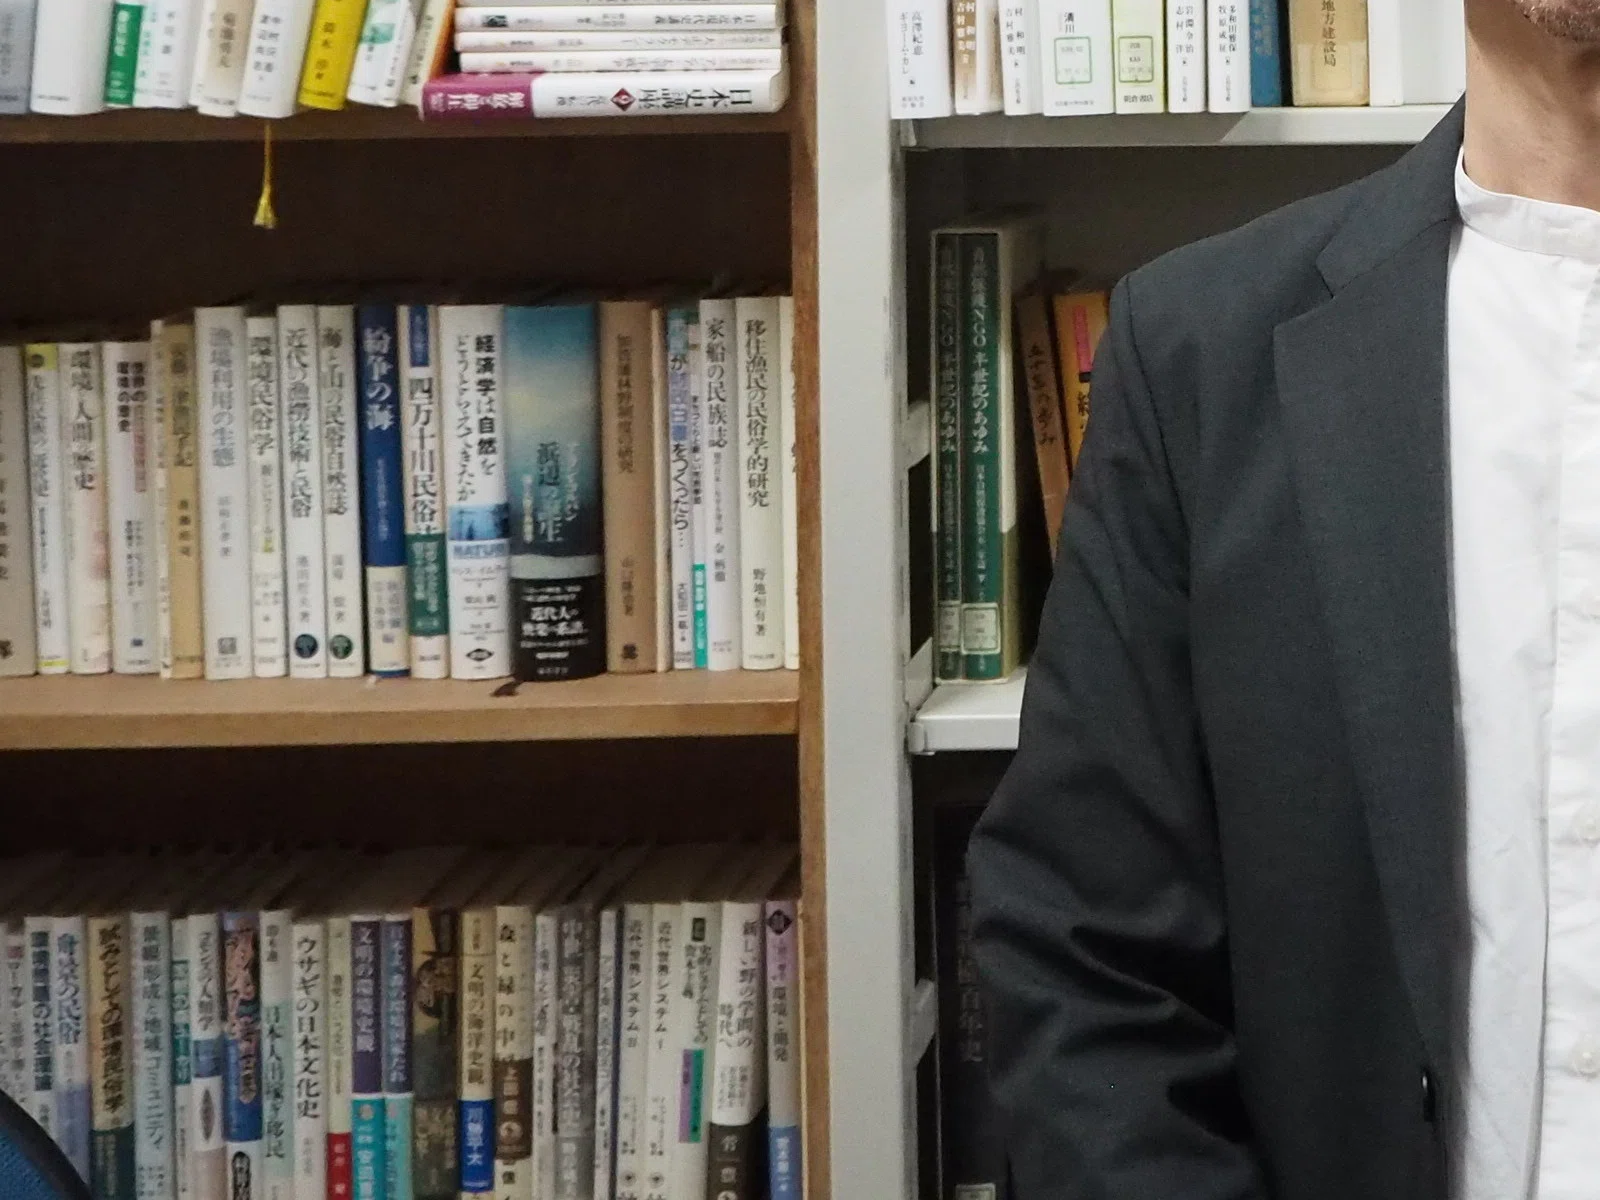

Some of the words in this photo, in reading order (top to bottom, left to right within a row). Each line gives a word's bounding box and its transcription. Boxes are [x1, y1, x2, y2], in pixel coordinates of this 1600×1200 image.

[637, 87, 753, 111] 日本史講座
[363, 326, 396, 431] 紛争の海
[475, 334, 497, 477] 経済学は自然を
[744, 318, 770, 509] 移住漁民の民俗学的研究
